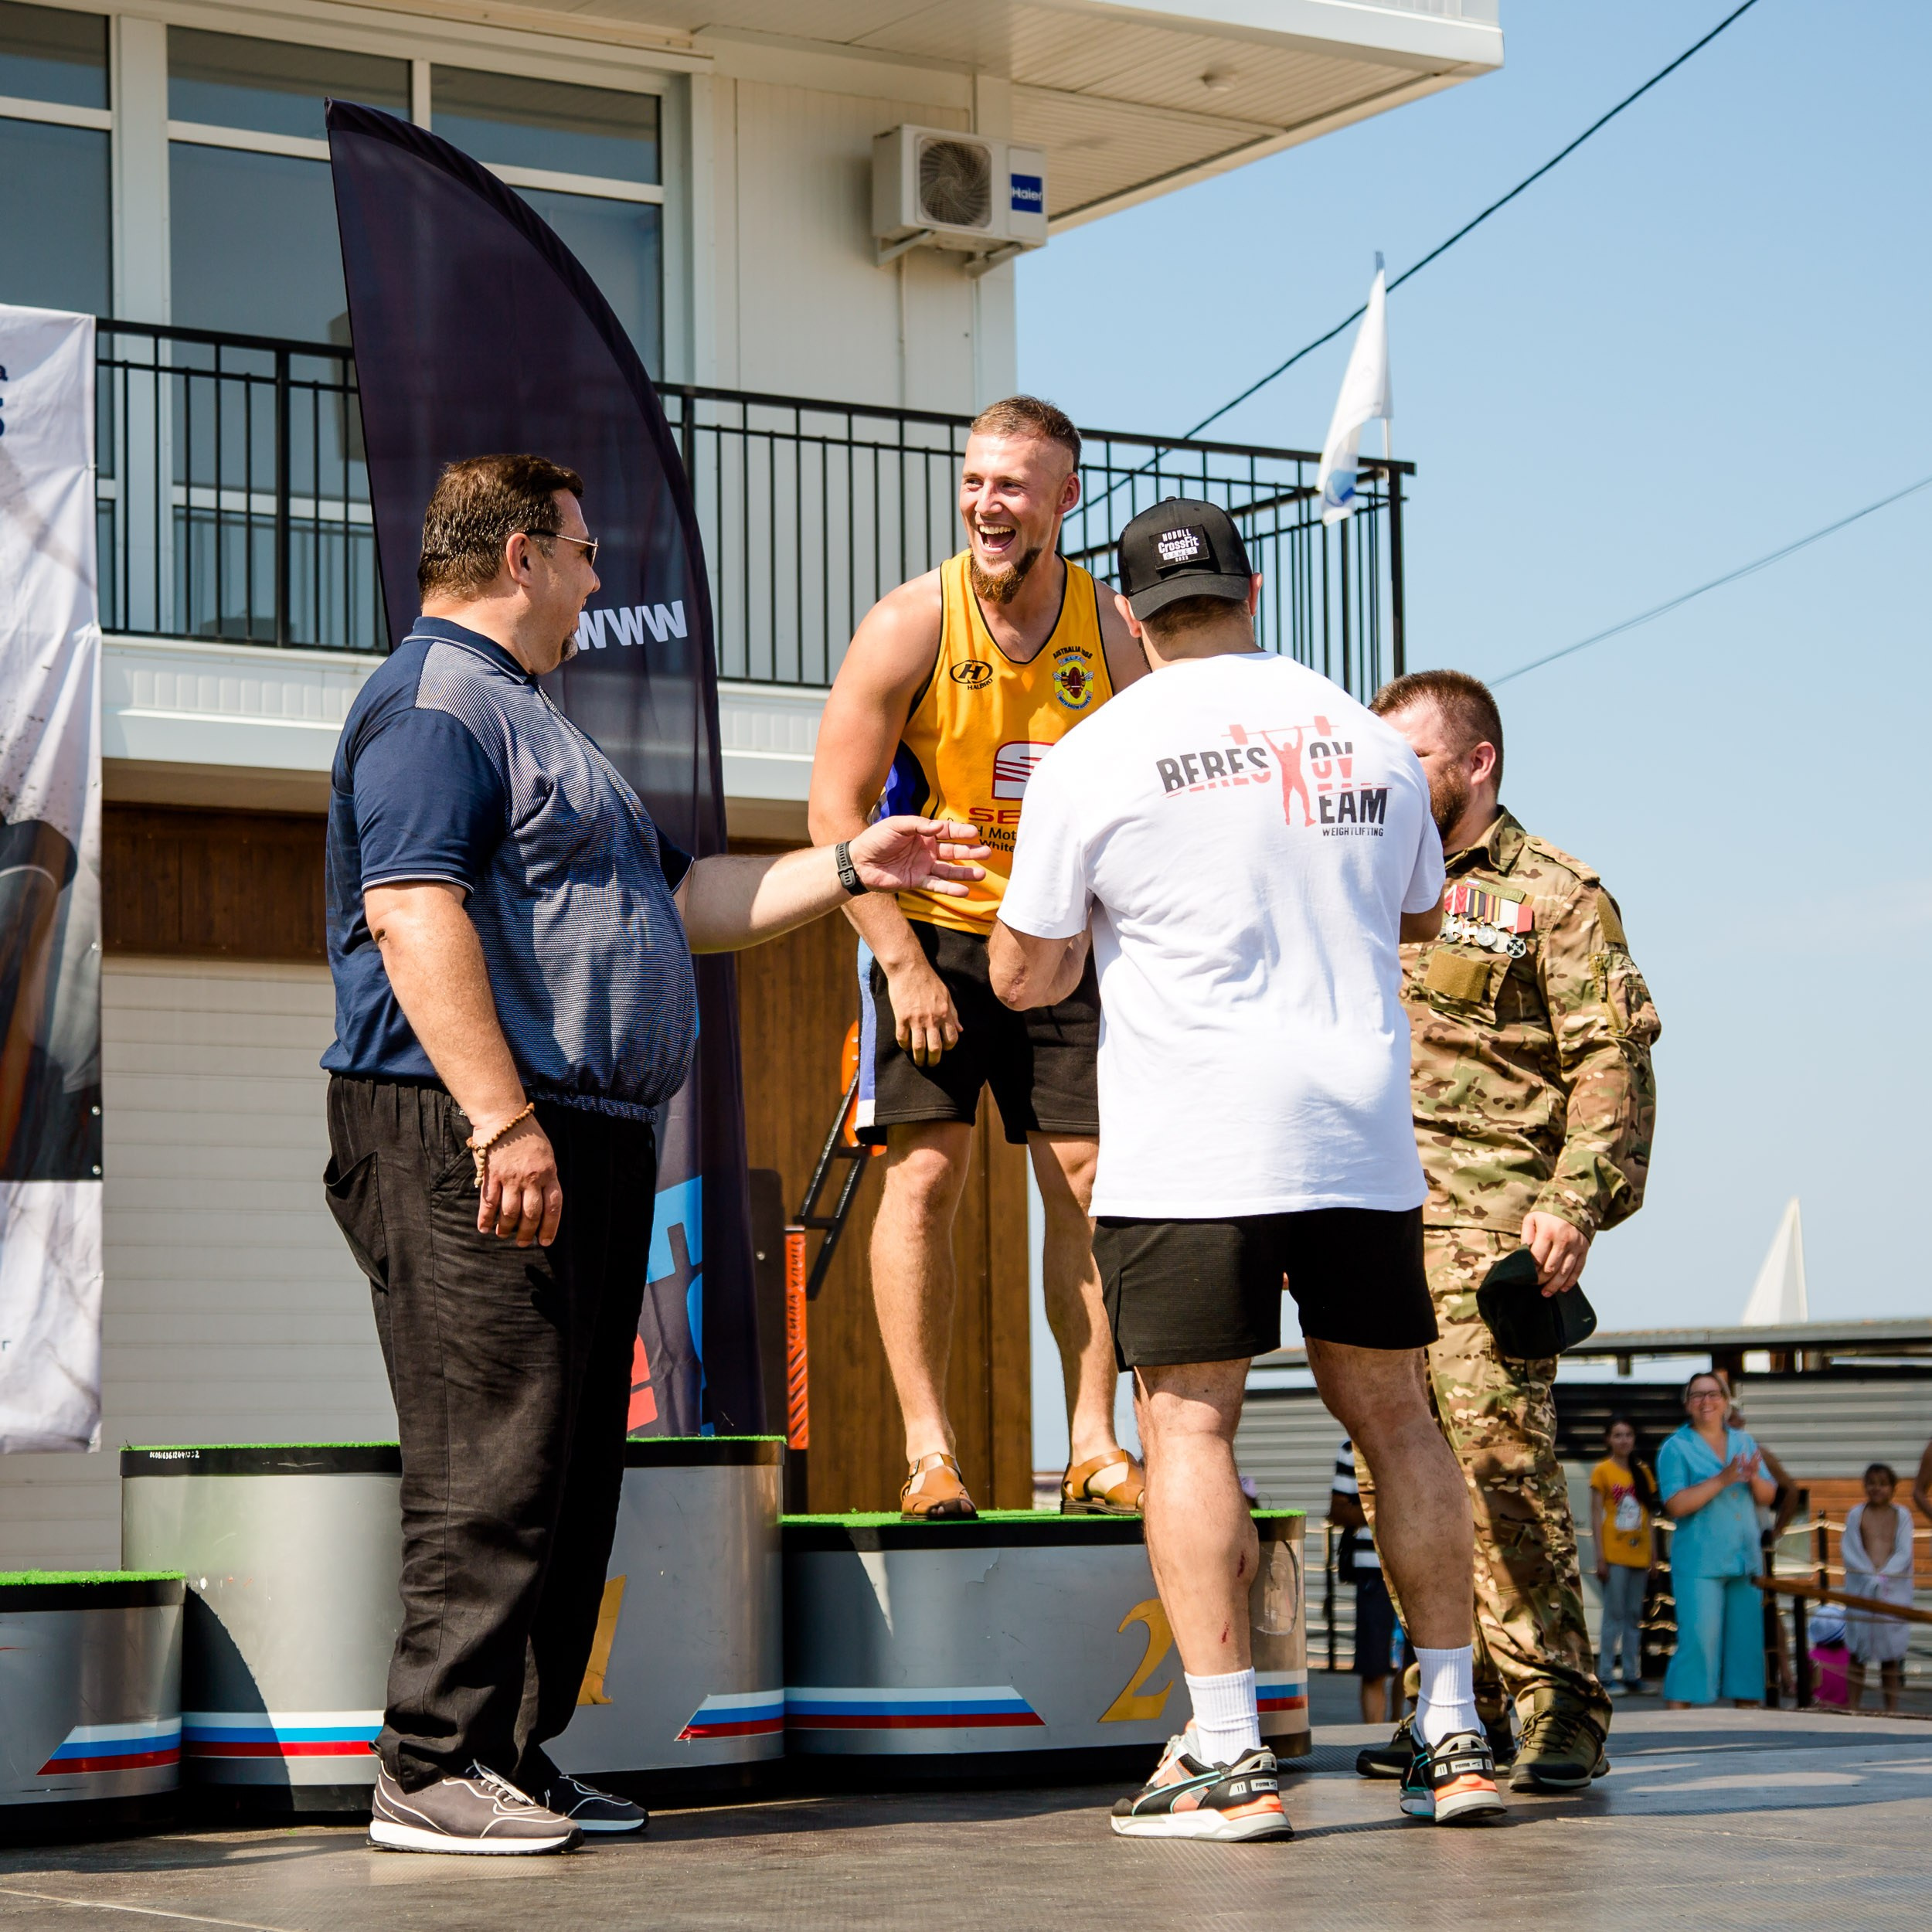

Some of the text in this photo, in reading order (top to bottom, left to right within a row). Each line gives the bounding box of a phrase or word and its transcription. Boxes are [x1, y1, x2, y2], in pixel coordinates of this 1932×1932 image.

[1012, 186, 1043, 201] Haier
[1162, 528, 1192, 542] NOBULL
[1158, 536, 1199, 554] CrossFit
[1165, 549, 1196, 559] GAMES
[968, 807, 1021, 825] SE
[988, 827, 1017, 841] Mot
[1322, 826, 1384, 838] WEIGHTLIFTING
[979, 838, 1015, 852] White
[1097, 1597, 1175, 1723] 2
